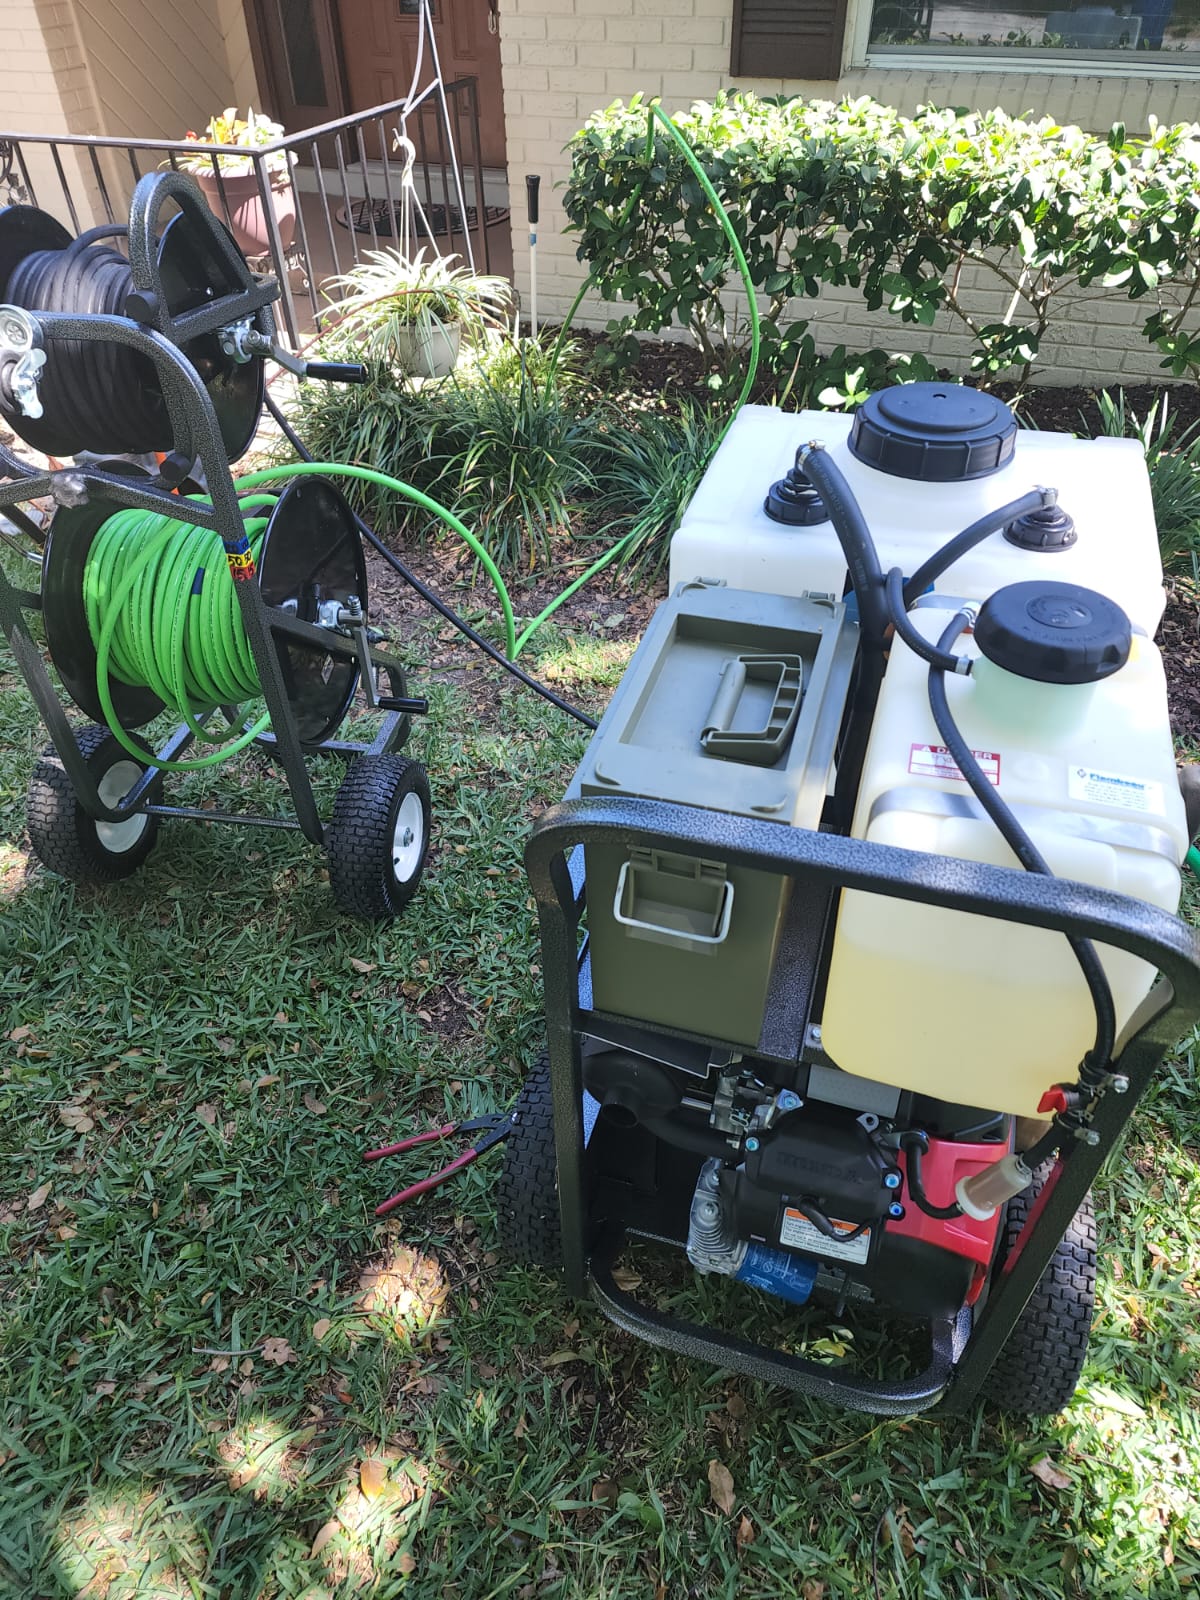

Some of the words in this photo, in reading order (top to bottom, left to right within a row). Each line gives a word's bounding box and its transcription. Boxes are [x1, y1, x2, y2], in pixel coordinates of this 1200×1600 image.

[228, 555, 242, 566] 50
[233, 568, 245, 580] 15
[936, 746, 993, 760] DER
